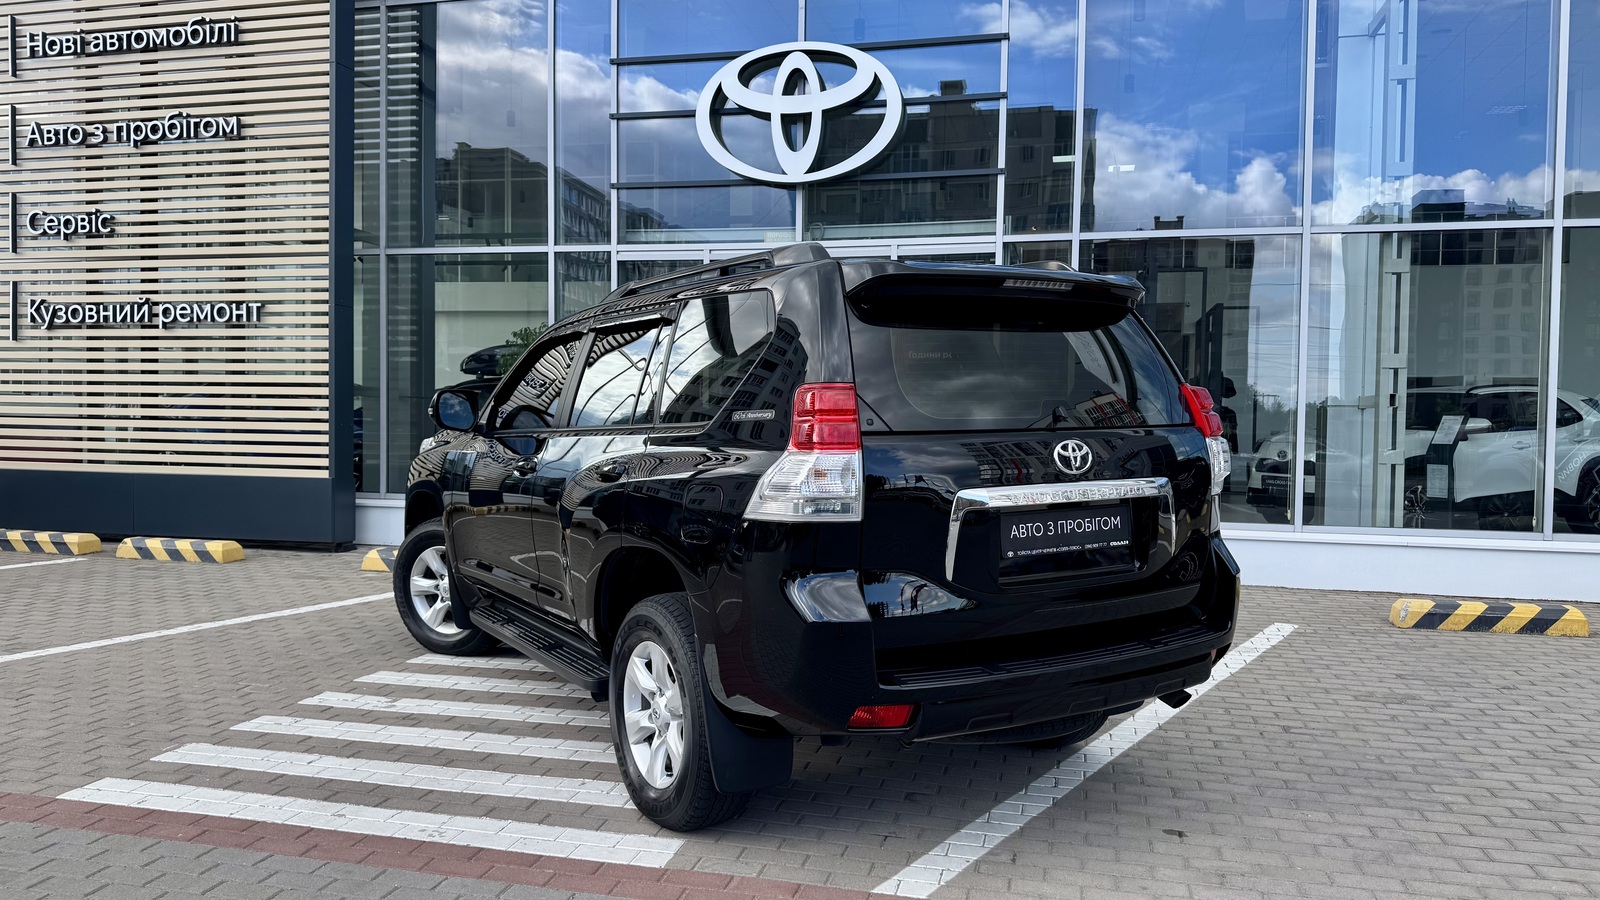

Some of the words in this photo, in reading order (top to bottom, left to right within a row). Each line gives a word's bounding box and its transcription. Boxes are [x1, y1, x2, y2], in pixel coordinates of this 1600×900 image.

[26, 28, 85, 57] Нові
[91, 16, 239, 52] автомобілі
[26, 121, 87, 147] Авто
[91, 124, 108, 144] з
[113, 111, 241, 148] пробігом
[26, 208, 115, 241] Сервіс
[27, 296, 152, 330] Кузовний
[158, 302, 265, 330] ремонт
[908, 350, 940, 360] Години
[1010, 522, 1043, 539] АВТО
[1057, 515, 1121, 534] ПРОБІГОМ
